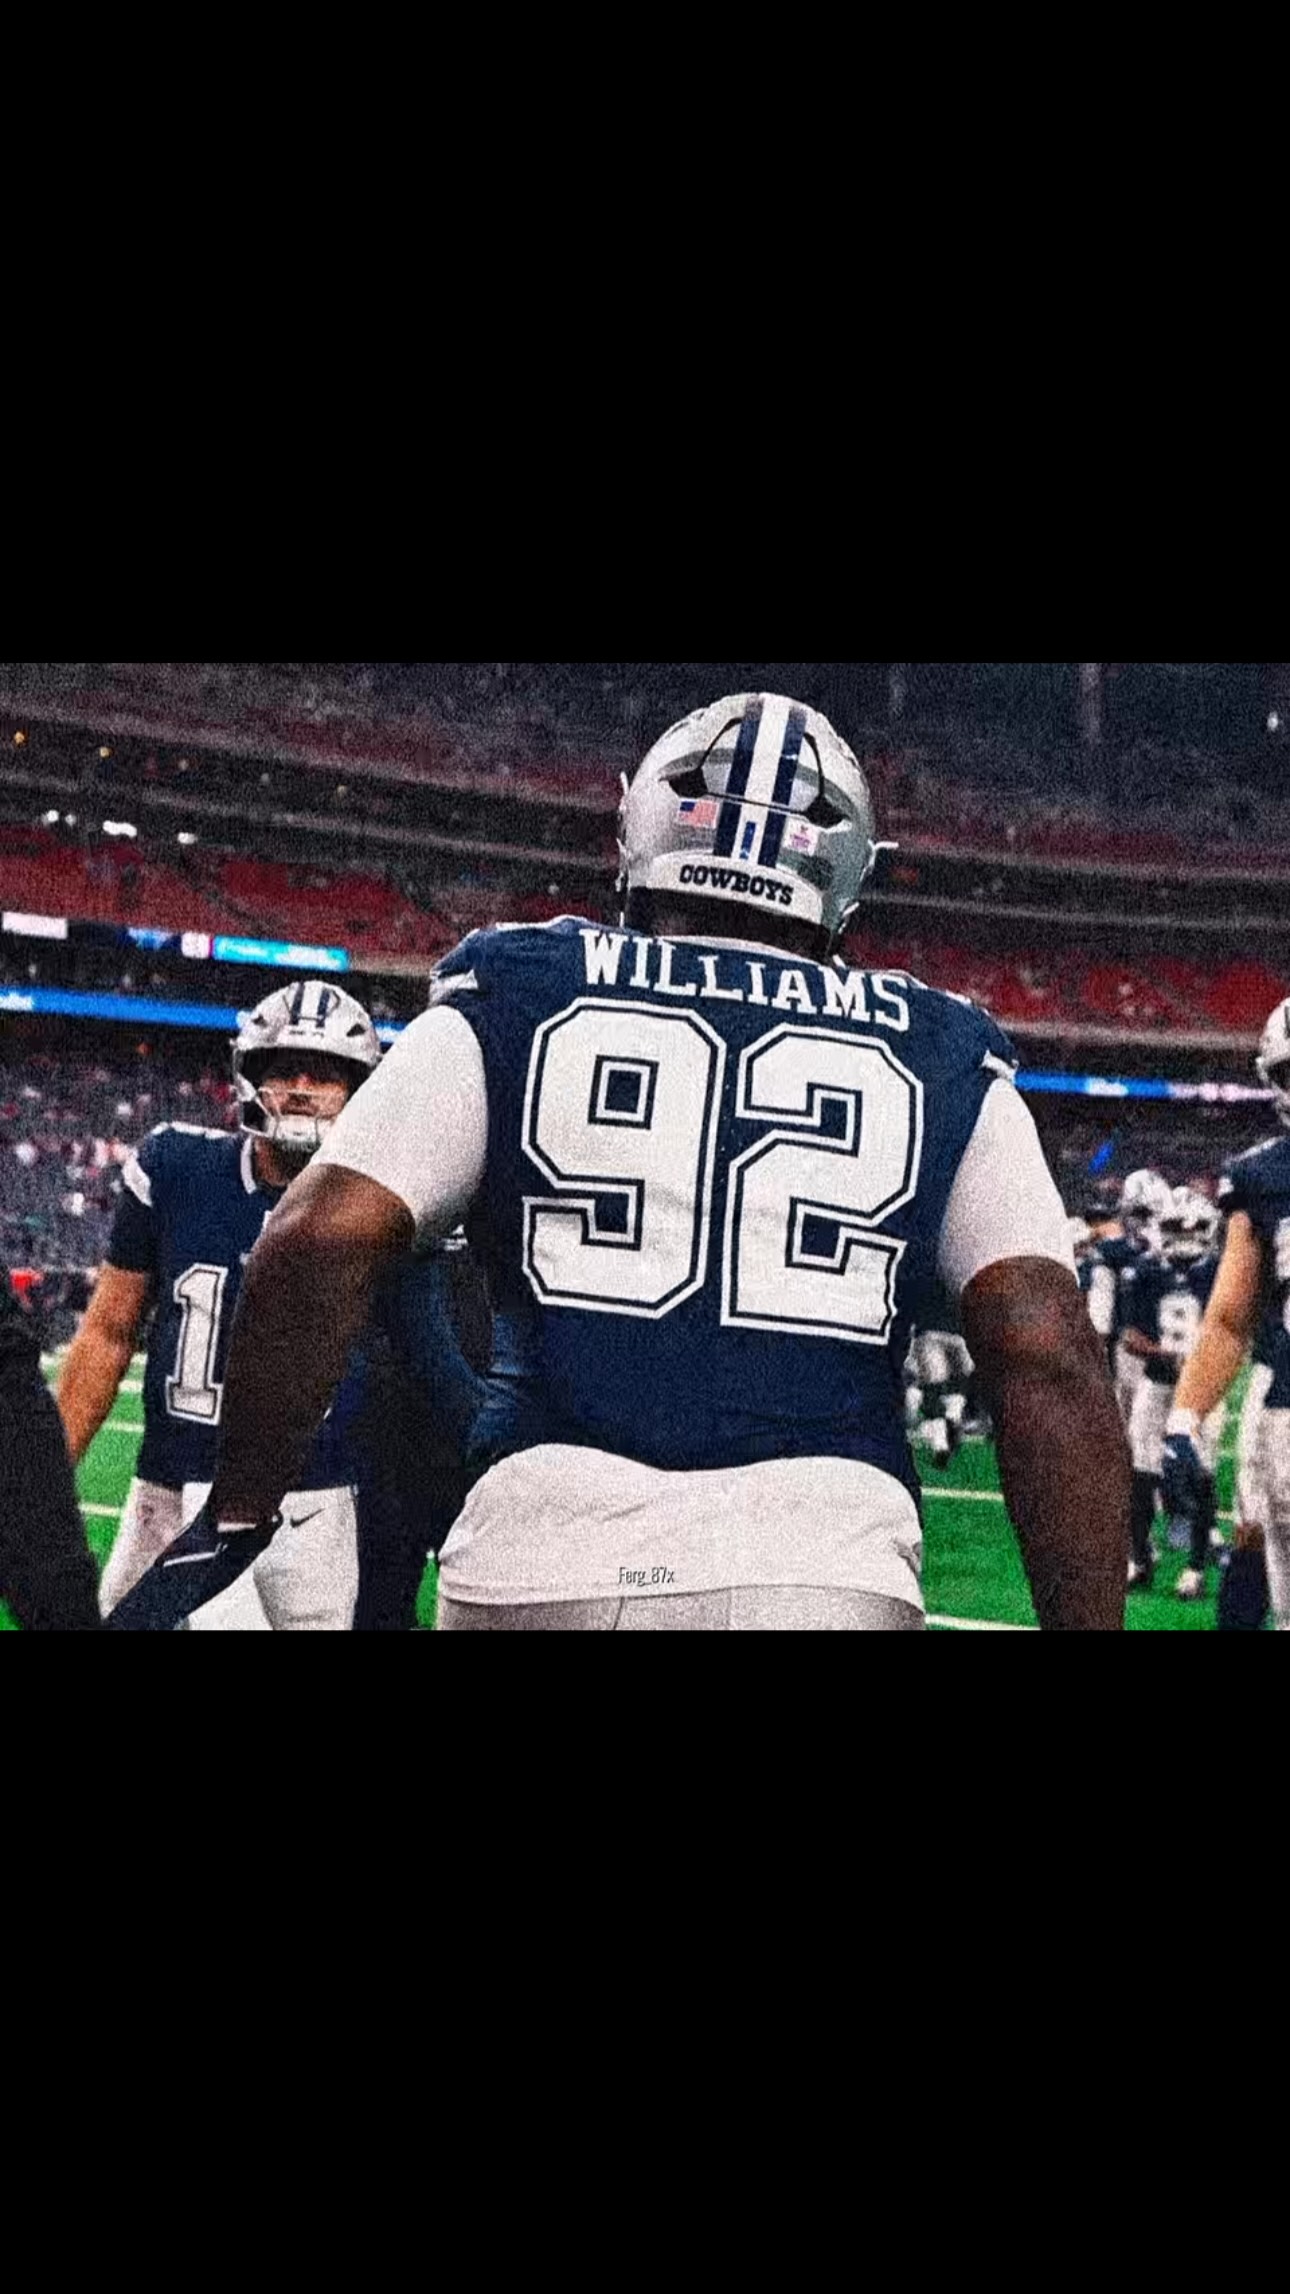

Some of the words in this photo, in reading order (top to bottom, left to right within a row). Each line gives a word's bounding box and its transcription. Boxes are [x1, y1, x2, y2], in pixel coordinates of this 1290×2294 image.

[679, 864, 794, 905] COWBOYS
[579, 928, 909, 1032] WILLIAMS
[521, 997, 923, 1346] 92
[165, 1262, 229, 1426] 1
